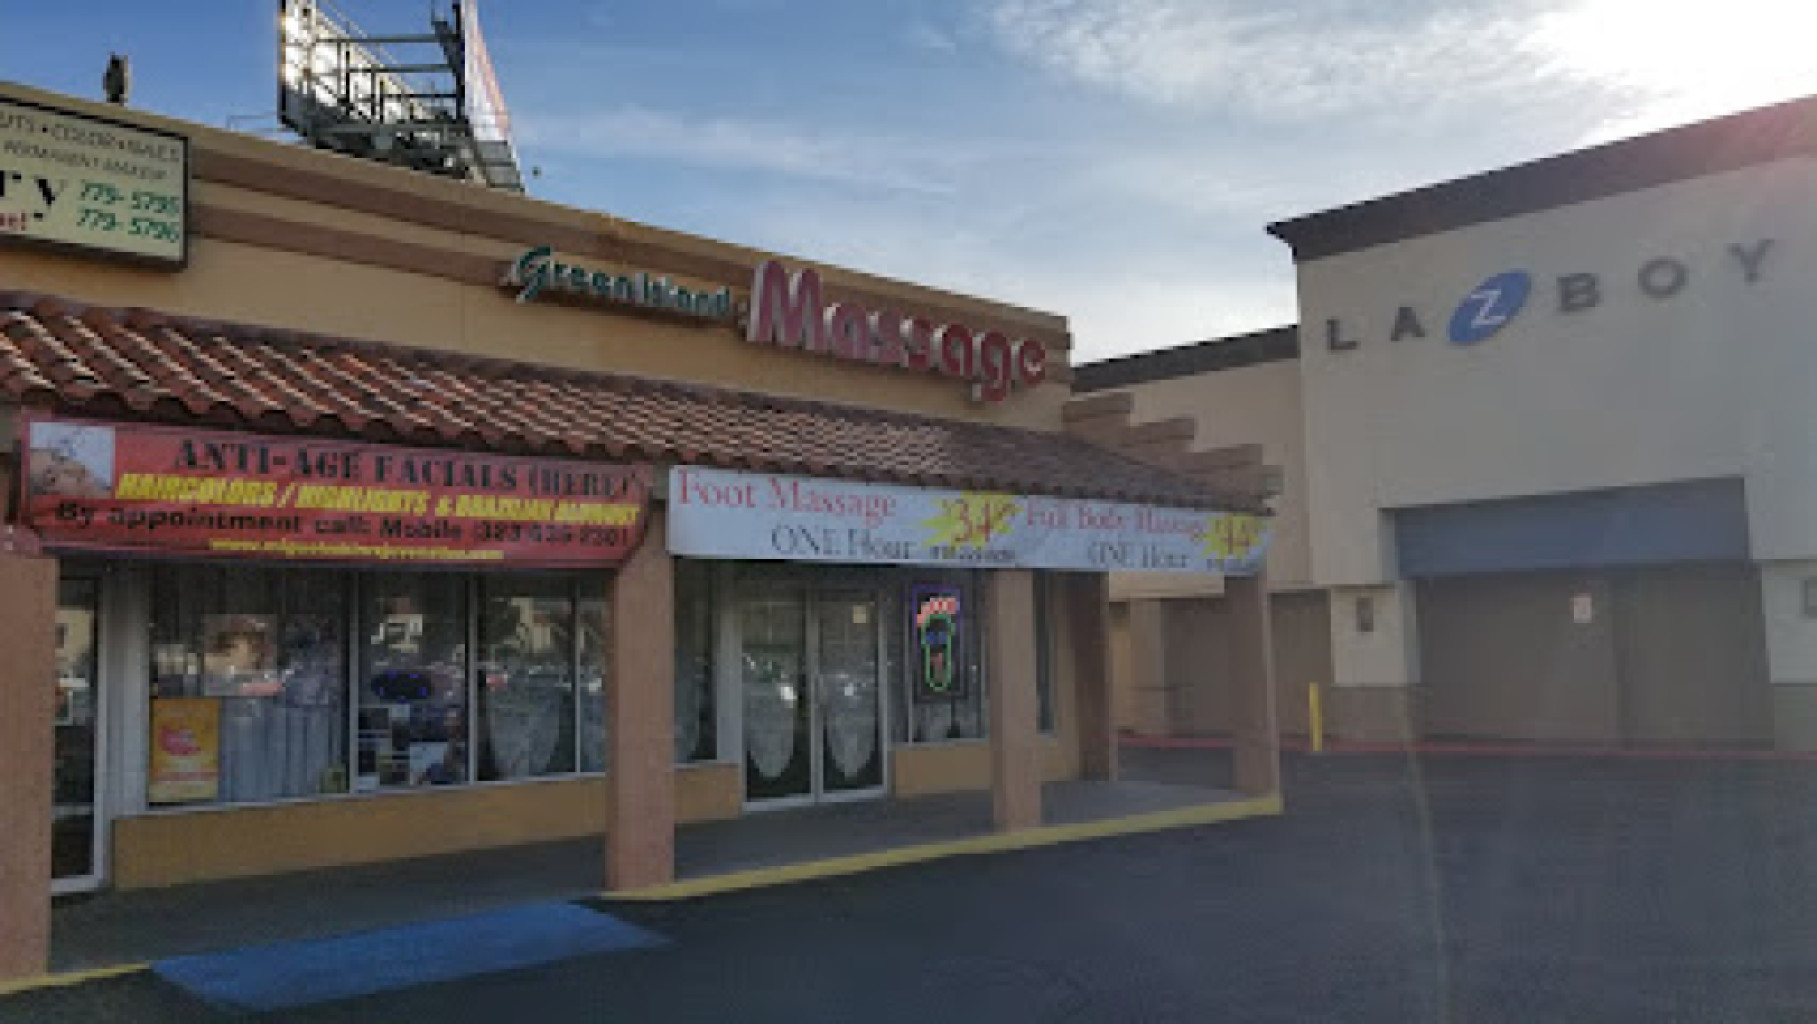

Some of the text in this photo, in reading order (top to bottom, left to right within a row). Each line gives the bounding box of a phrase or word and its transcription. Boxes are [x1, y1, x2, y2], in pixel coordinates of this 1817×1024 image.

[513, 245, 634, 301] Green
[748, 260, 1046, 402] Massage
[174, 439, 362, 481] ANTI-AGE
[373, 454, 519, 491] FACIALS
[54, 502, 95, 529] By
[106, 506, 303, 534] appointment
[676, 466, 897, 530] Foot Massage
[771, 523, 842, 557] ONE
[846, 527, 917, 561] Hour
